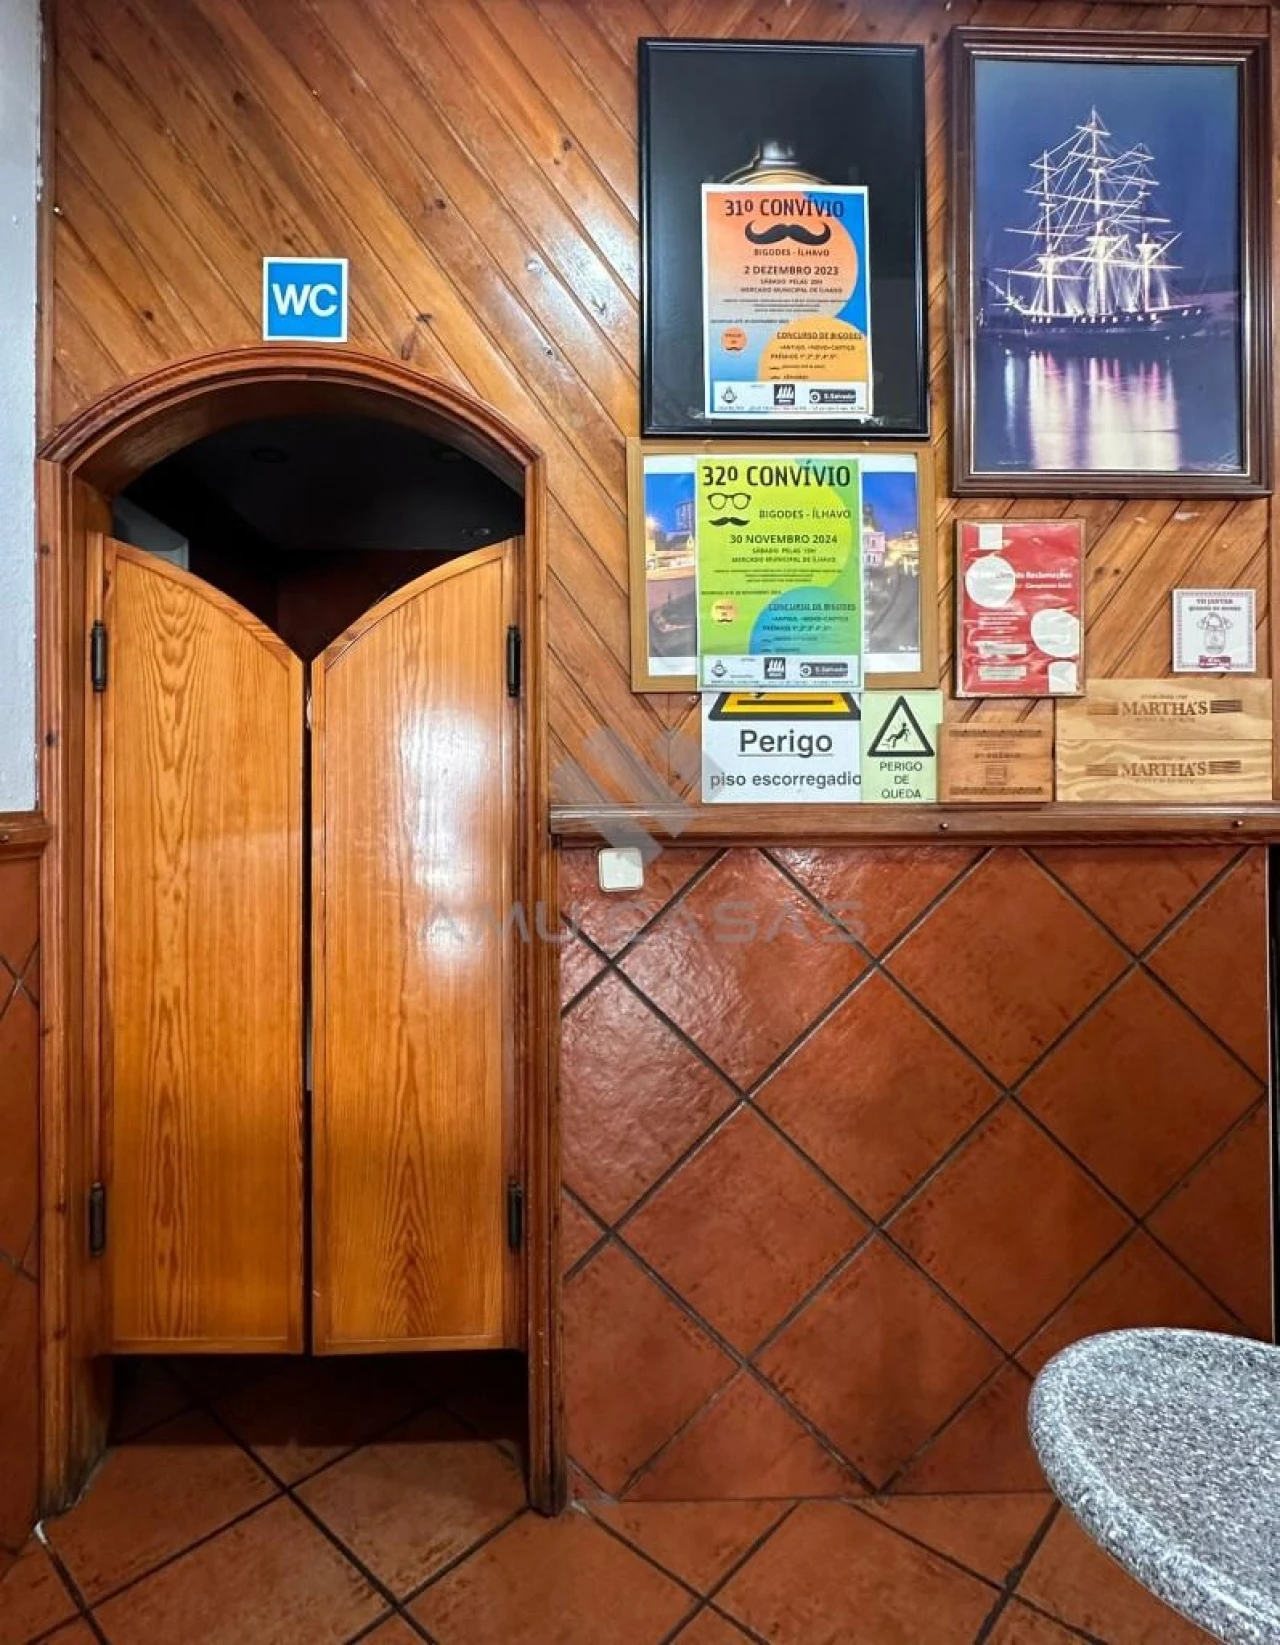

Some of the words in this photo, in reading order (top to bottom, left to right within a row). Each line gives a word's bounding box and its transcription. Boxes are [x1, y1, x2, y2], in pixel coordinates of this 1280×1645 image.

[725, 199, 754, 216] 31º
[760, 194, 844, 218] CONVÍVIO
[754, 248, 791, 257] BIGODES
[797, 247, 830, 257] ÍLHAVO
[744, 266, 750, 274] 2
[753, 266, 812, 275] DEZEMBRO
[814, 266, 839, 276] 2023
[272, 283, 338, 317] WC
[702, 465, 739, 487] 32º
[746, 459, 851, 487] CONVÍVIO
[759, 510, 804, 520] BIGODES
[812, 508, 851, 520] ÍLHAVO
[730, 534, 743, 544] 30
[745, 534, 811, 544] NOVEMBRO
[812, 534, 838, 544] 2024
[739, 728, 834, 759] Perigo
[879, 761, 923, 772] PERIGO
[710, 772, 747, 790] piso
[752, 771, 862, 790] escorregadio
[893, 775, 910, 785] DE
[880, 788, 922, 800] QUEDA
